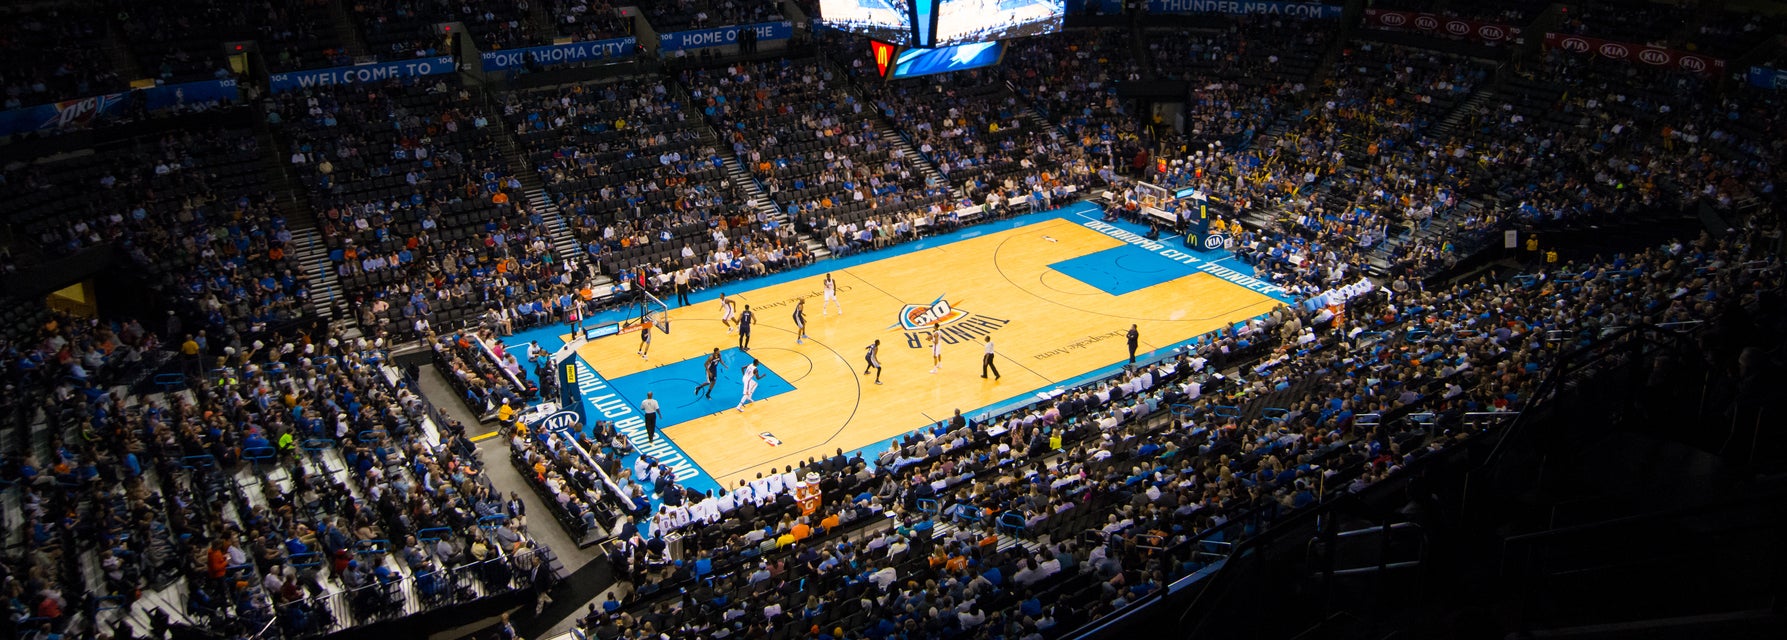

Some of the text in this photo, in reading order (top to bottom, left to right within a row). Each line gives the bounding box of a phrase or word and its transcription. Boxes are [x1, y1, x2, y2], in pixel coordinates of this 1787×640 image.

[1160, 0, 1323, 19] THUNDER.NBACOM
[660, 33, 673, 41] 106
[682, 31, 723, 46] HOME
[438, 57, 453, 65] 104
[482, 52, 496, 60] 105
[495, 42, 625, 67] OKLAHOMA CITY
[219, 79, 236, 88] 103
[271, 73, 288, 83] 104
[297, 62, 432, 88] WELCOME TO
[60, 97, 96, 126] OKC
[1083, 219, 1278, 294] OKLAHOMA CITY THUNDER
[914, 299, 951, 326] OKC
[588, 393, 632, 418] CITY
[548, 413, 573, 430] KIA
